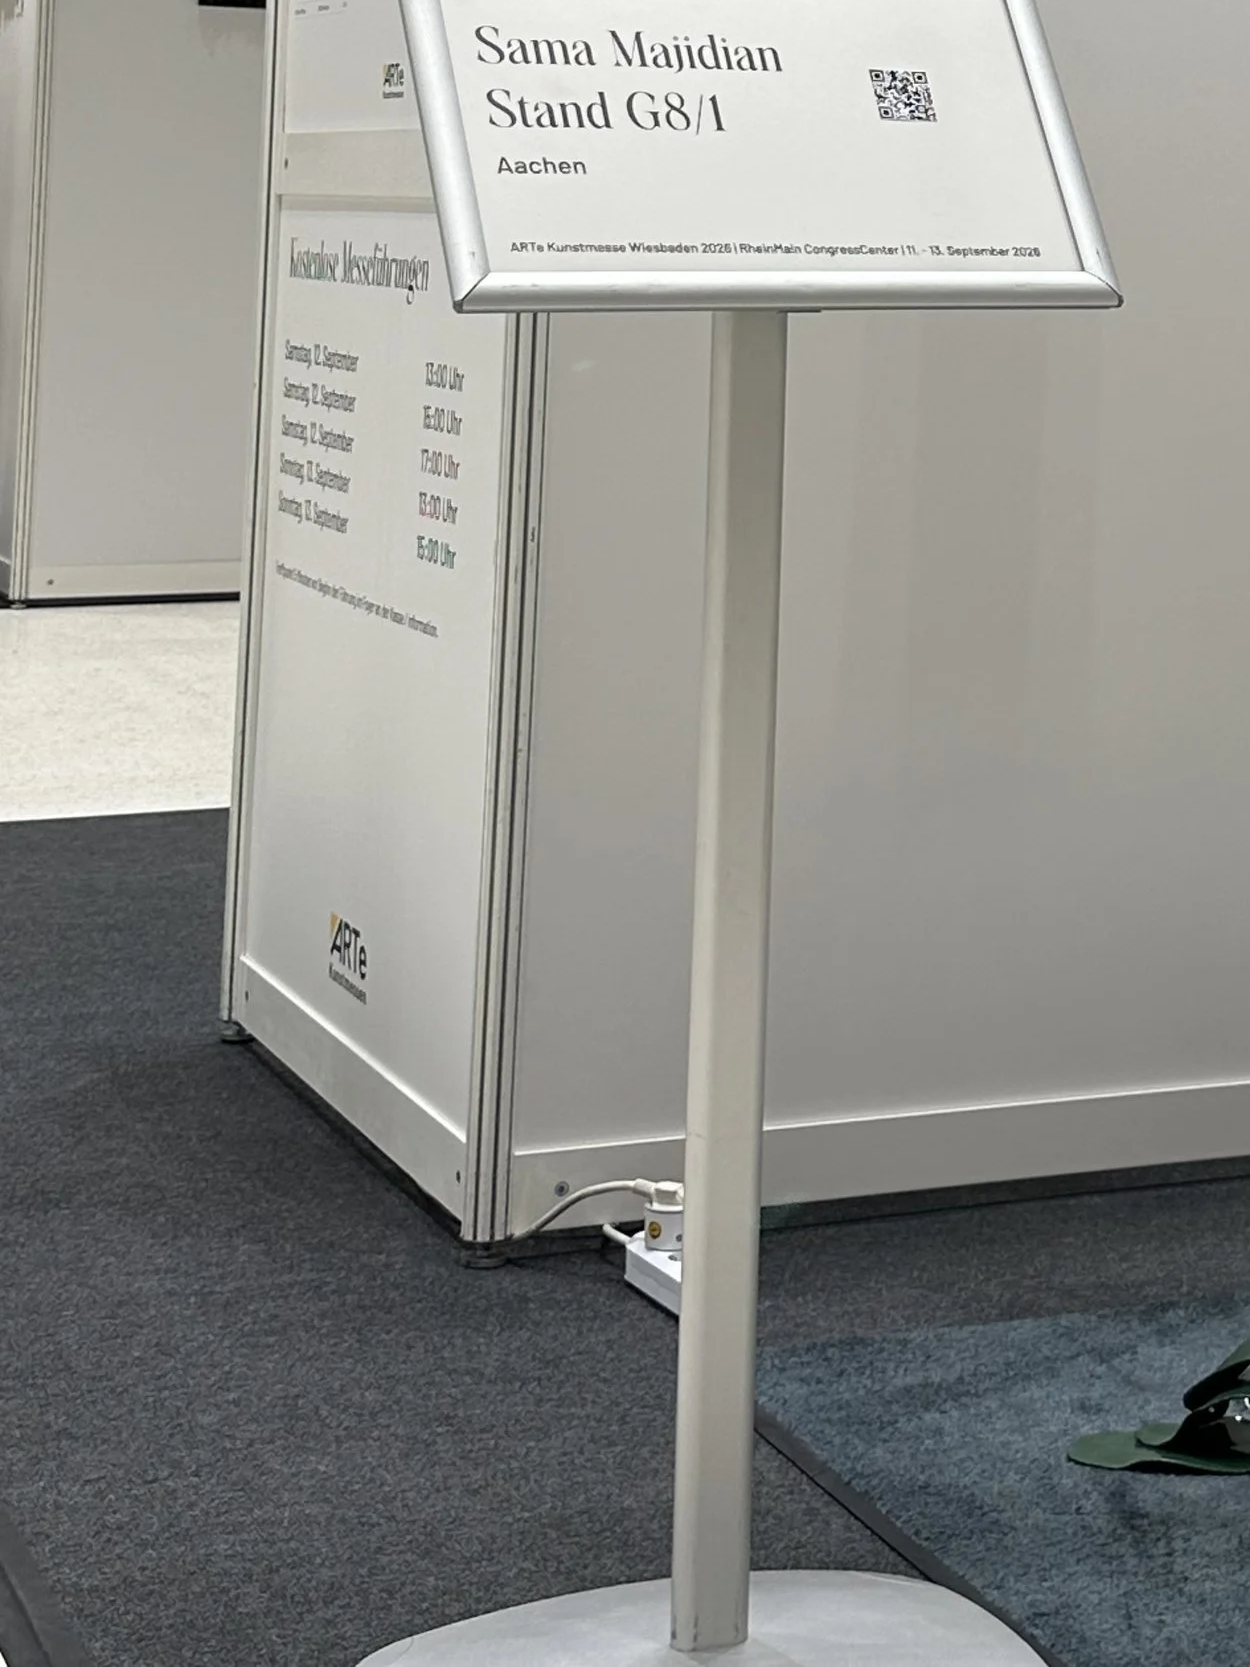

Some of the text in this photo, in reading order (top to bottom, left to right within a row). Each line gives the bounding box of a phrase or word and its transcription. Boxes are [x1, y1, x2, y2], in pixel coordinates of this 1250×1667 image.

[474, 25, 783, 74] Sama Majidian
[486, 88, 727, 135] Stand G8/1
[496, 155, 587, 175] Aachen
[510, 241, 544, 253] ARTe
[547, 241, 626, 253] Kunstmesse
[628, 241, 699, 254] Wiesbaden
[803, 243, 899, 257] CongressCenter
[946, 245, 1010, 258] September
[330, 917, 367, 980] ARTe
